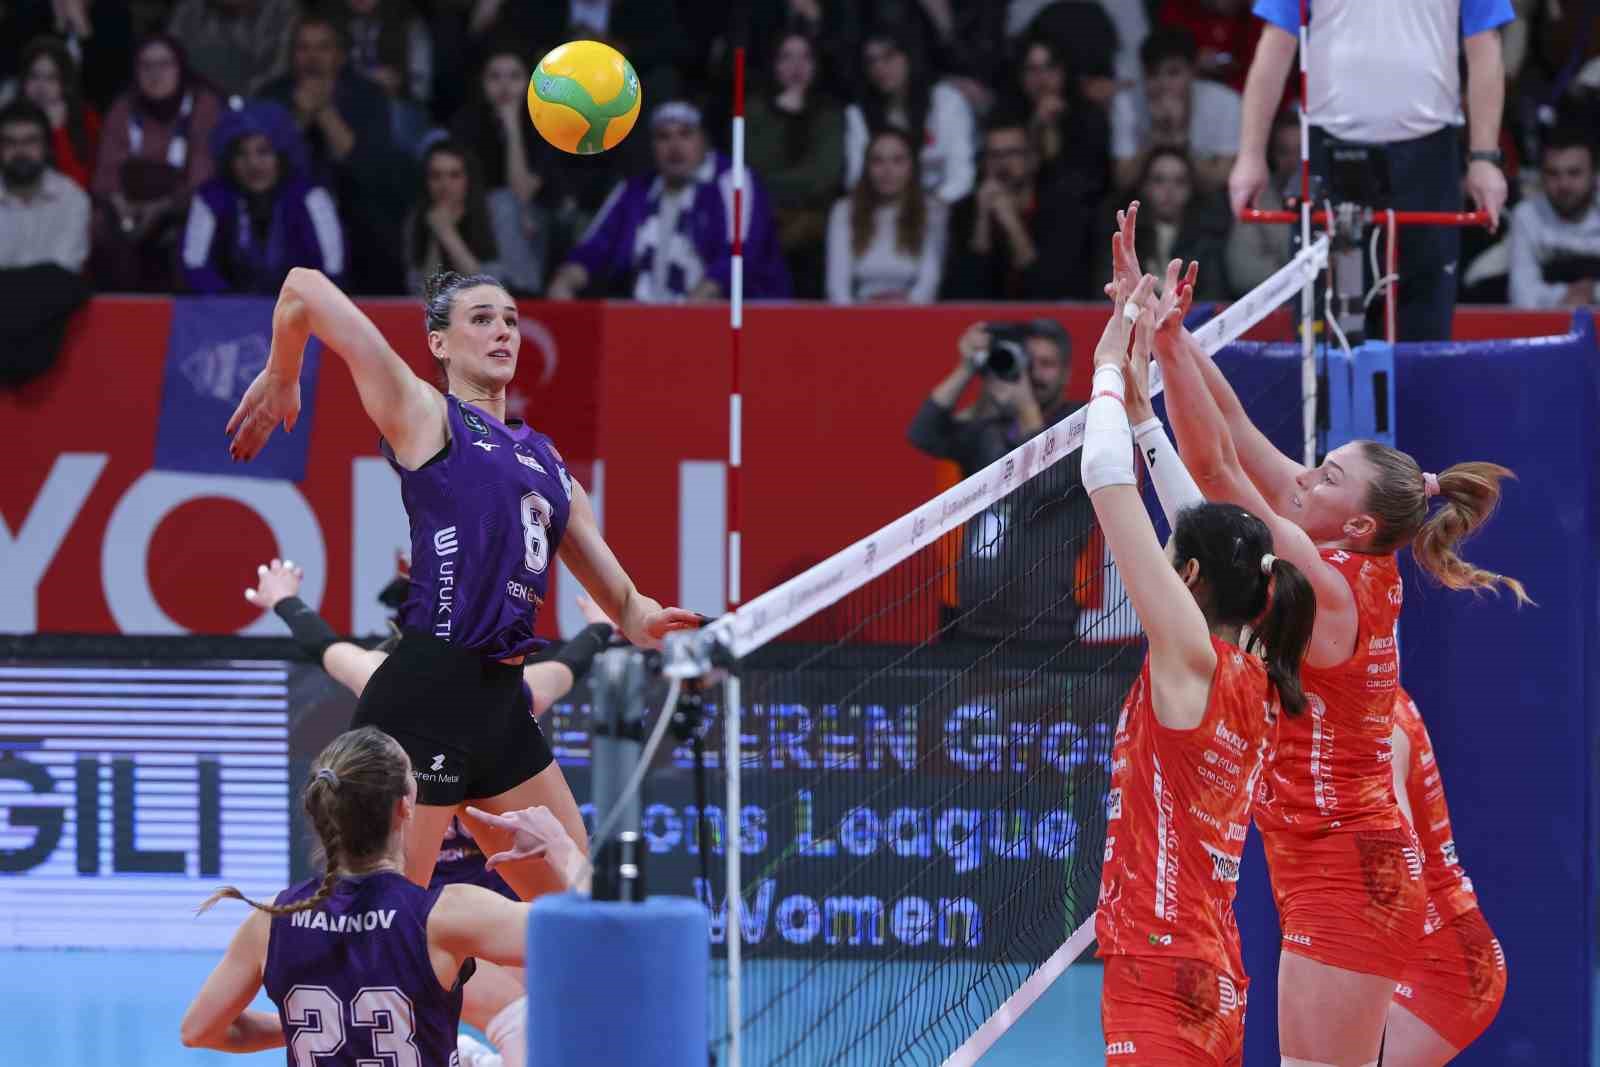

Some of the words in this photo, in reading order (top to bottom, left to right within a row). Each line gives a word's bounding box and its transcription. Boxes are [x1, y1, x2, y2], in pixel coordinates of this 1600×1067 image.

[520, 491, 552, 575] 8
[438, 561, 454, 614] UFUK
[795, 789, 1079, 873] League
[694, 878, 983, 948] Women
[284, 983, 422, 1067] 23
